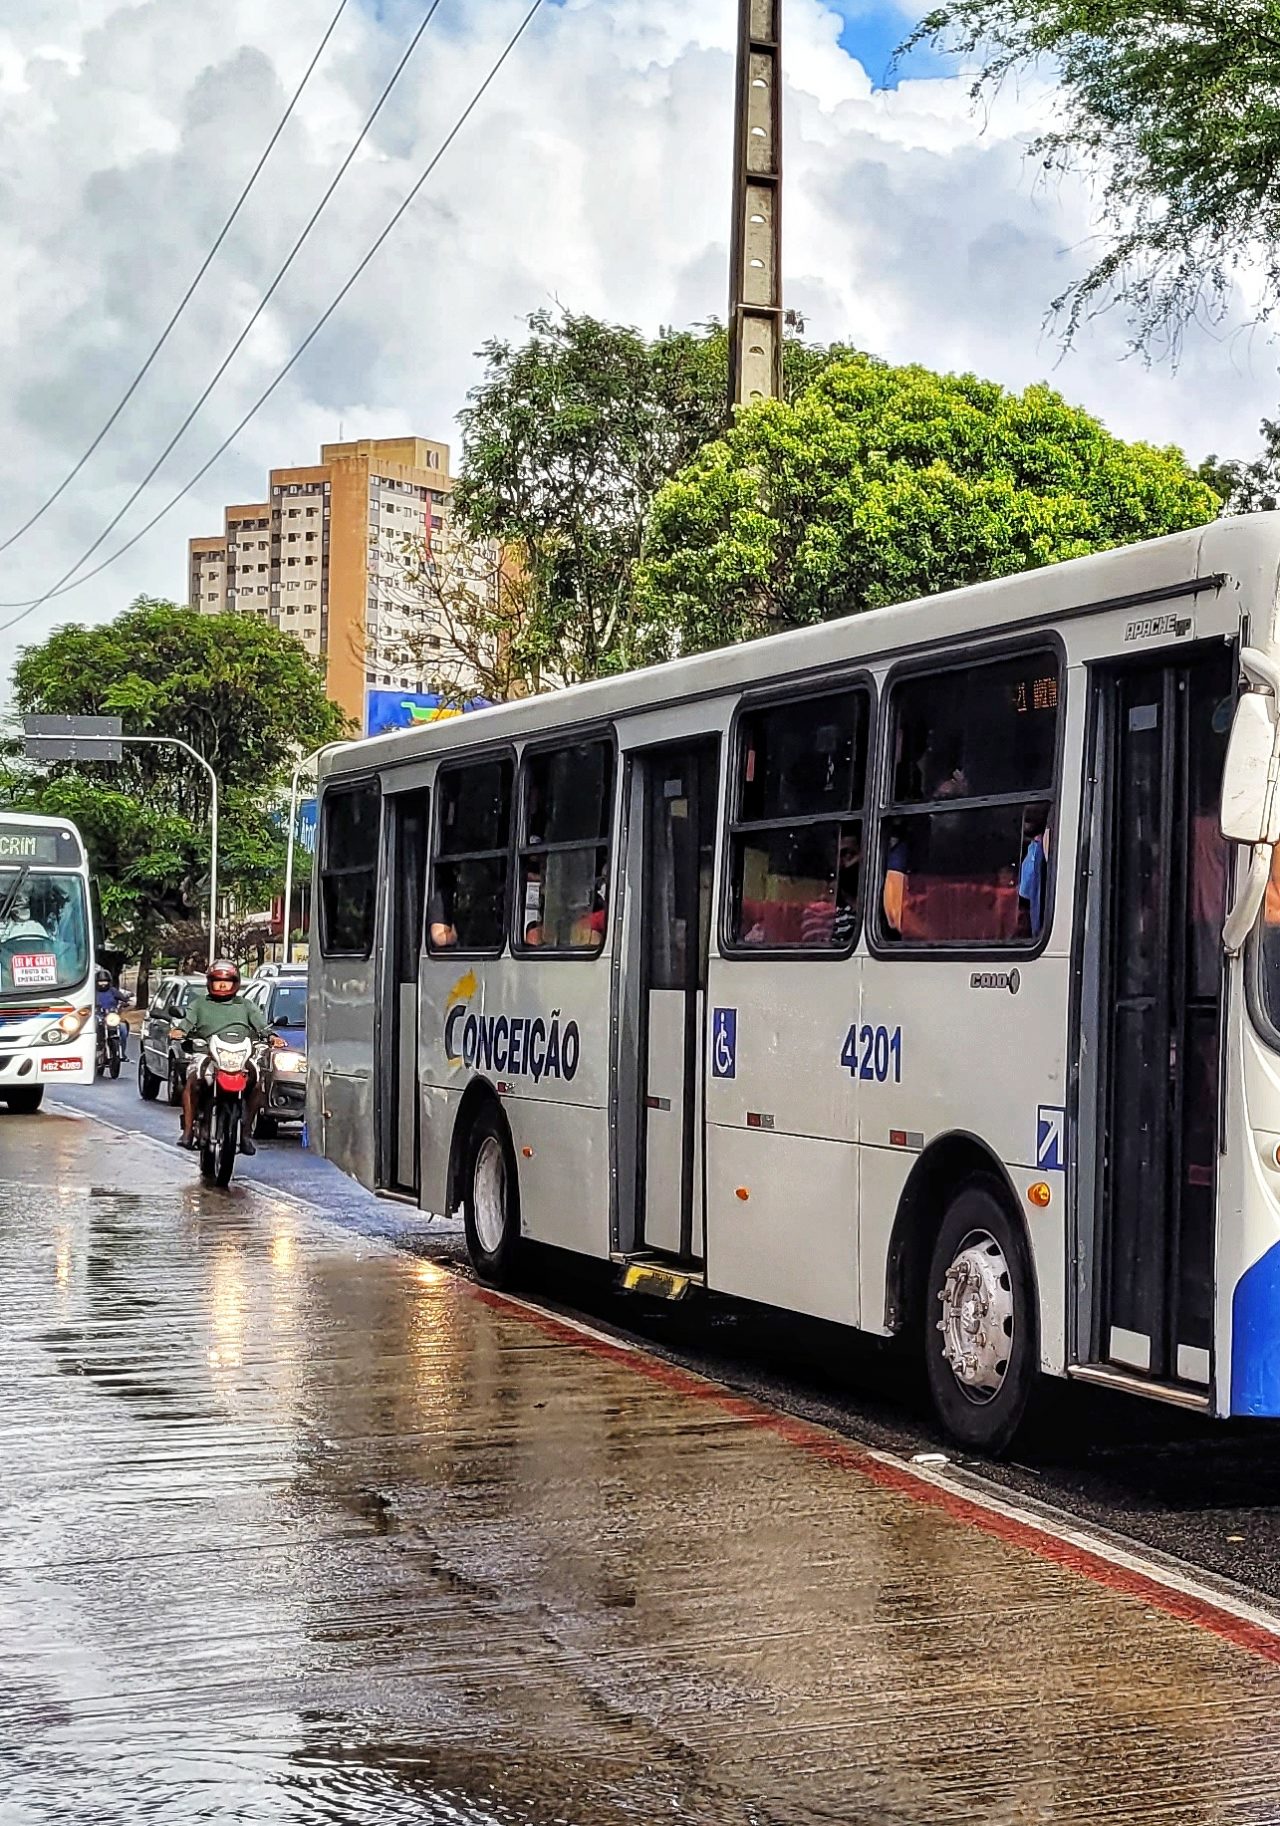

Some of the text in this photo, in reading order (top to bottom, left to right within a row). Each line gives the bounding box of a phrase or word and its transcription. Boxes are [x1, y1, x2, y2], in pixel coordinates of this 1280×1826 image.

[1124, 613, 1178, 641] APACHE
[970, 973, 1009, 989] CAIO
[444, 1004, 580, 1084] CONCEIÇÃO
[840, 1024, 902, 1083] 4201
